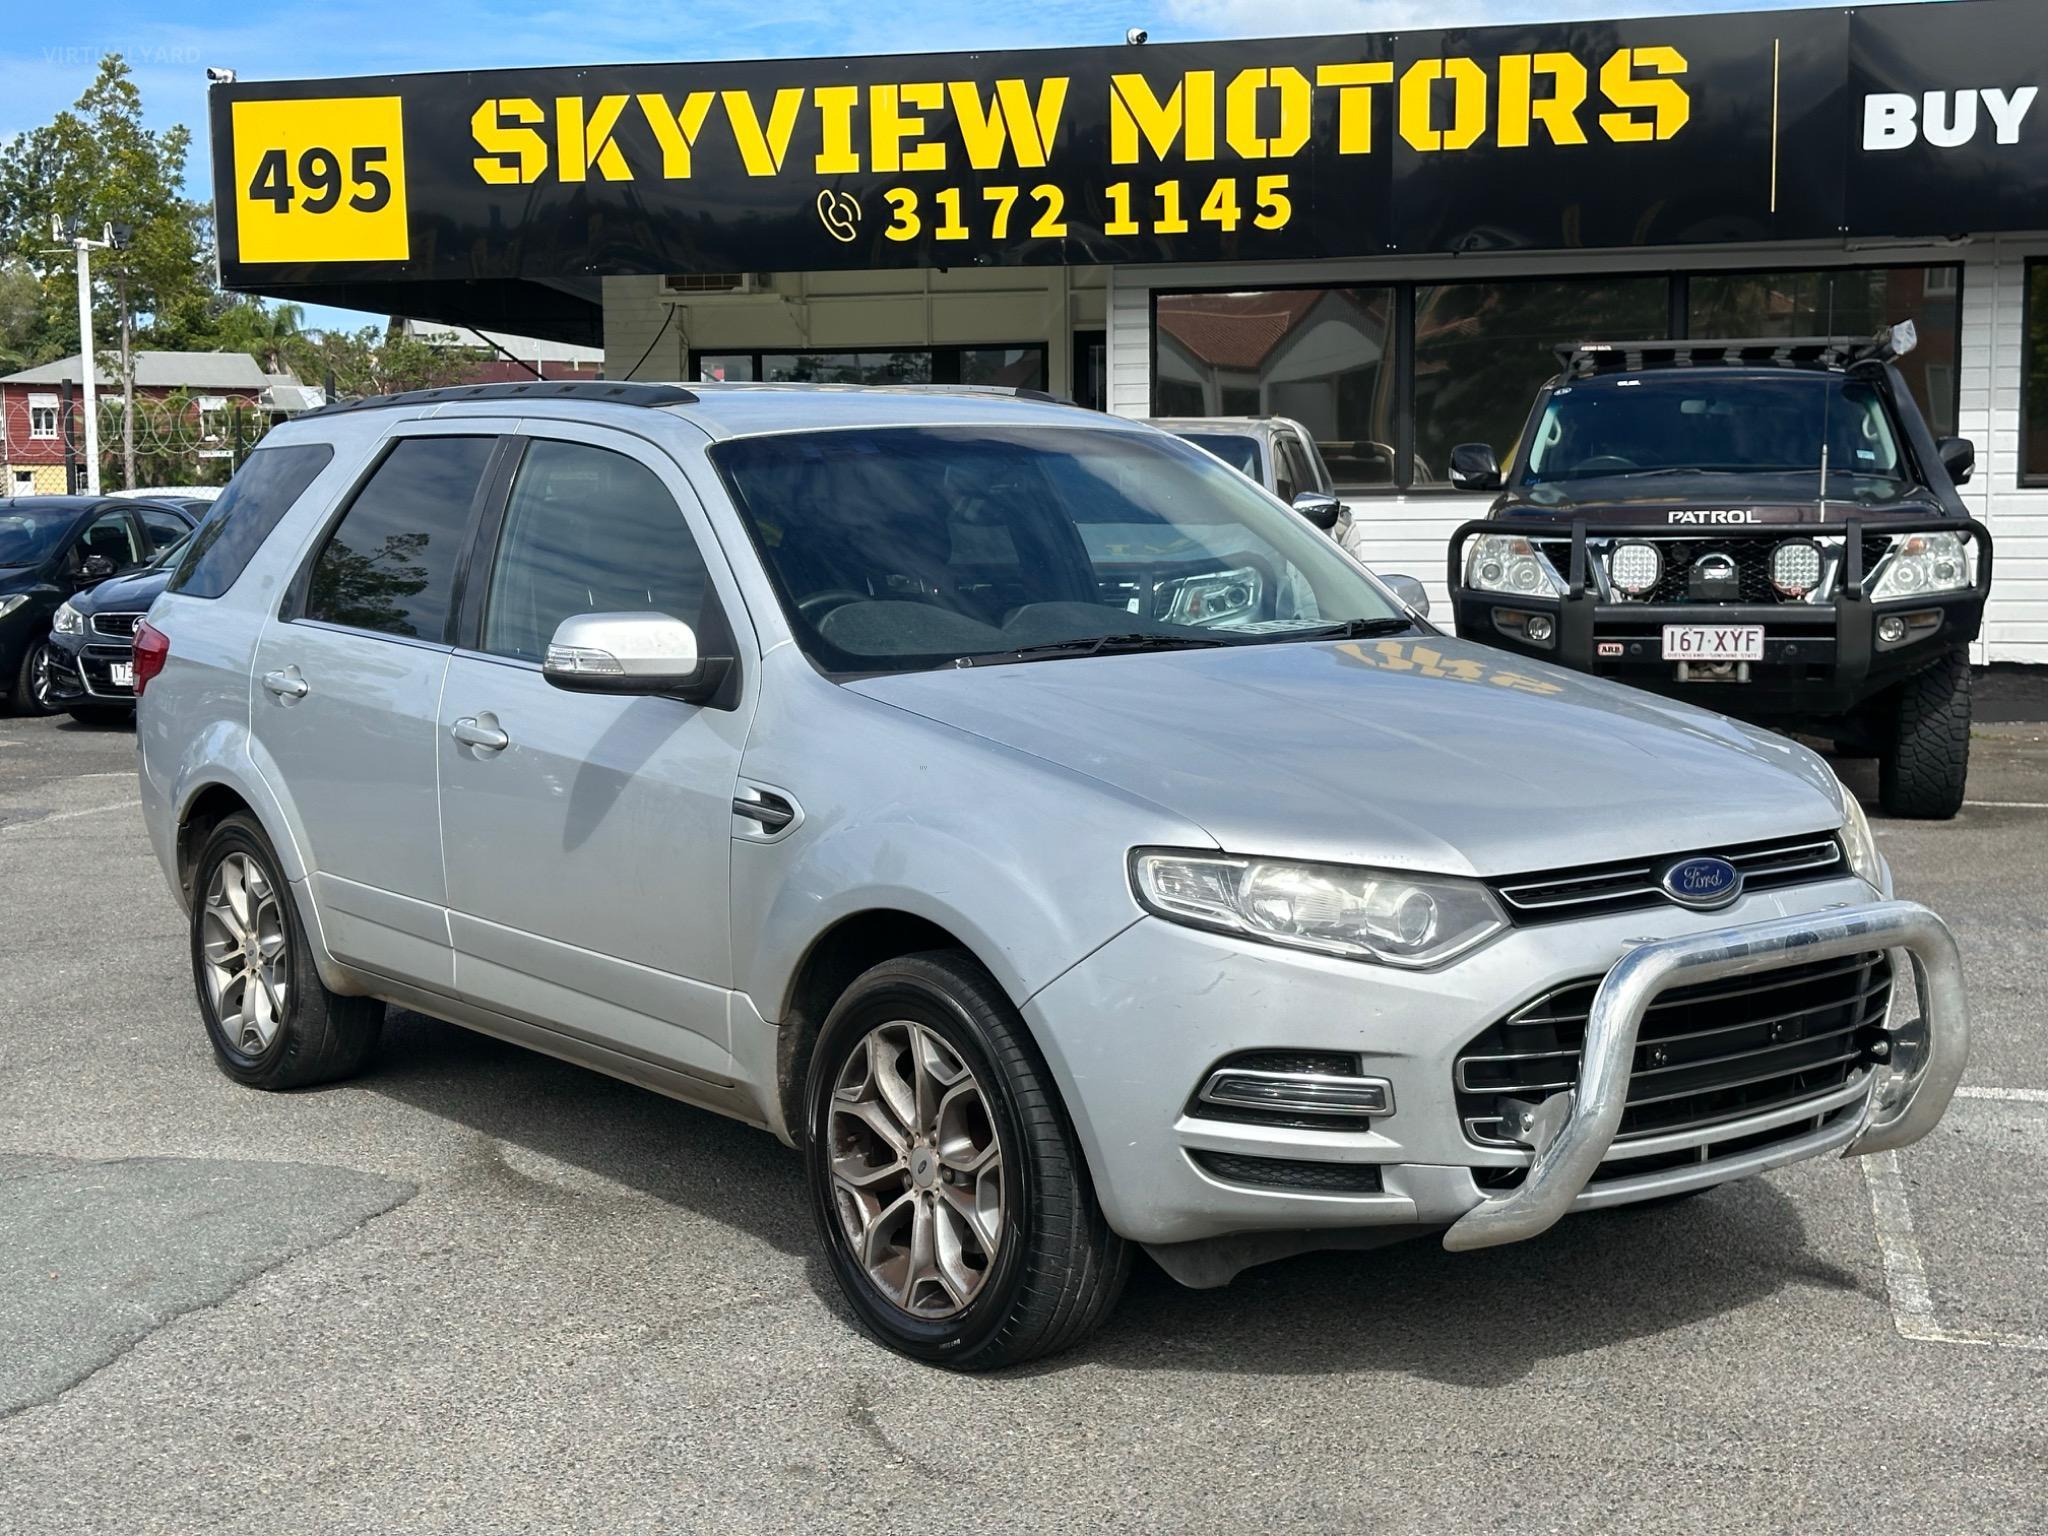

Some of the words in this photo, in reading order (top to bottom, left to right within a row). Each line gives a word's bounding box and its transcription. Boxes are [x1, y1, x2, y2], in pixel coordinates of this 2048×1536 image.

[471, 77, 1069, 184] SKYVIEW
[1110, 46, 1690, 165] MOTORS
[1863, 86, 2039, 150] BUY
[249, 146, 391, 214] 495
[884, 183, 1068, 242] 3172
[1104, 174, 1292, 236] 1145
[1667, 510, 1762, 524] PATROL
[1683, 865, 1723, 890] Ford
